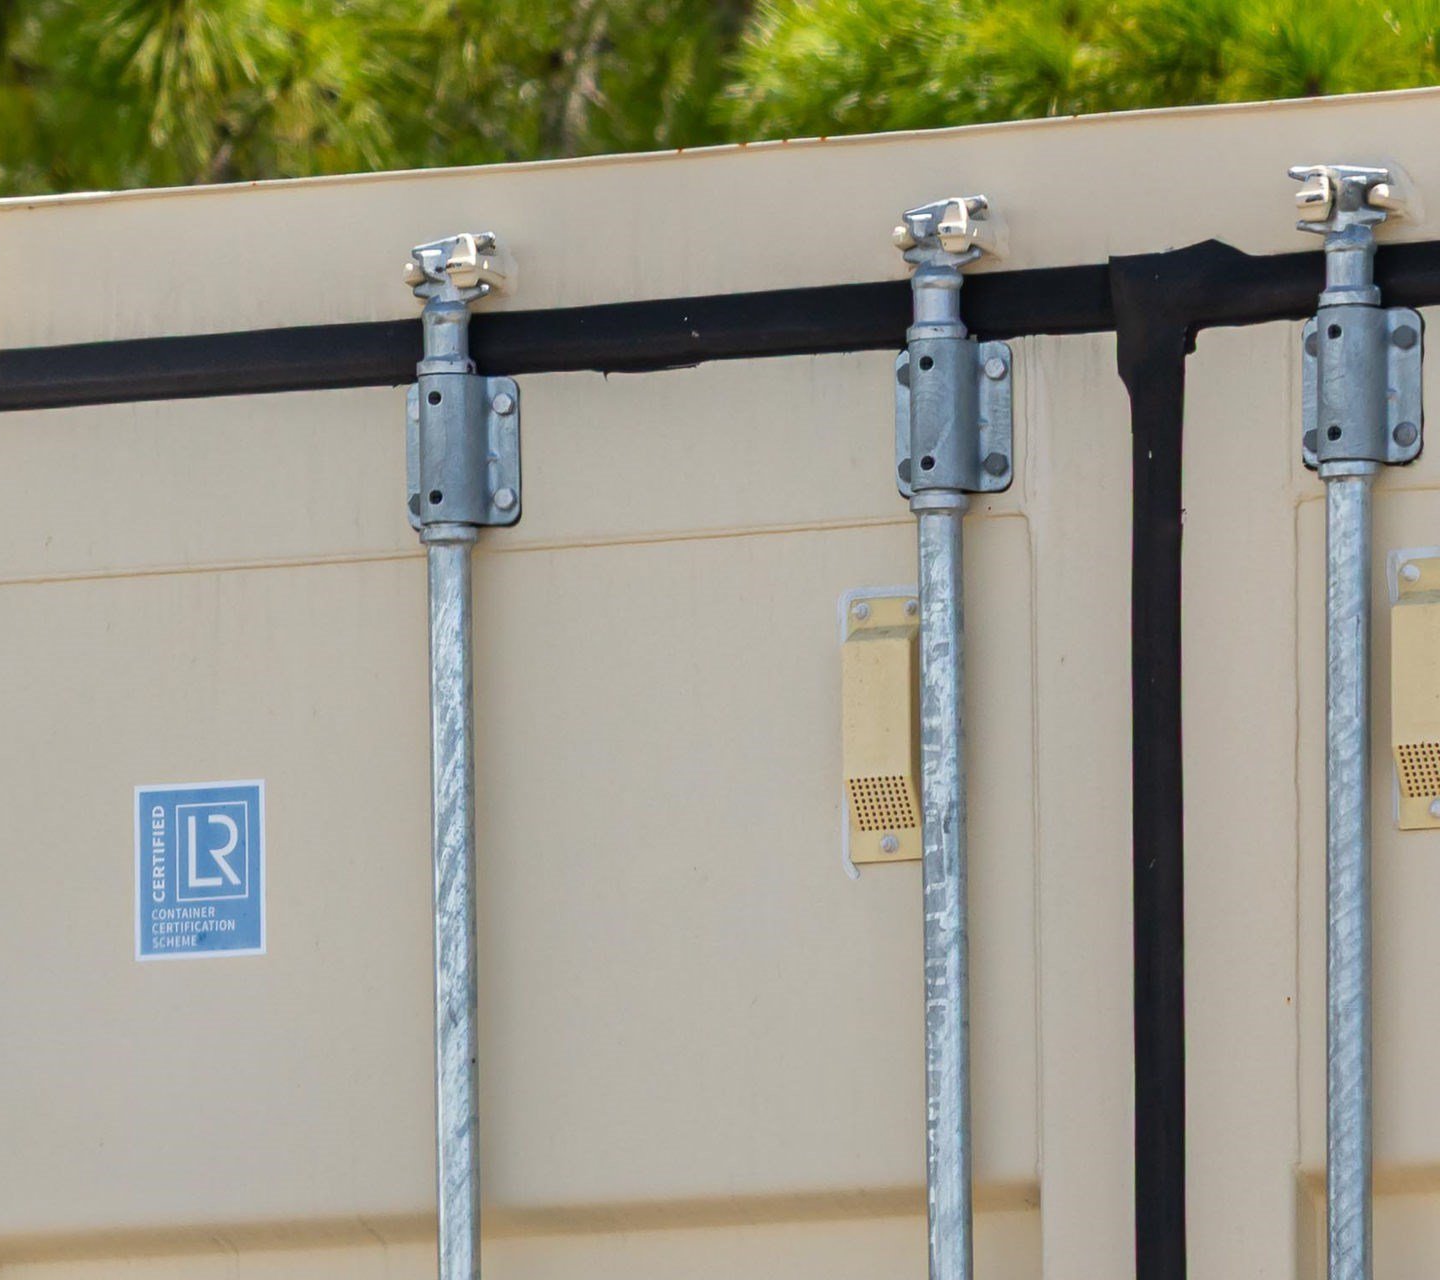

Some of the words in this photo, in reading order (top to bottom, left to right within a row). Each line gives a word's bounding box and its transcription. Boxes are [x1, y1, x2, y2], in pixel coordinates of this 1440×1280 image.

[152, 805, 166, 903] CERTIFIED
[187, 814, 242, 888] LR
[151, 906, 216, 920] CONTAINER
[151, 919, 236, 934] CERTIFICATION
[152, 935, 198, 949] SCHEME
